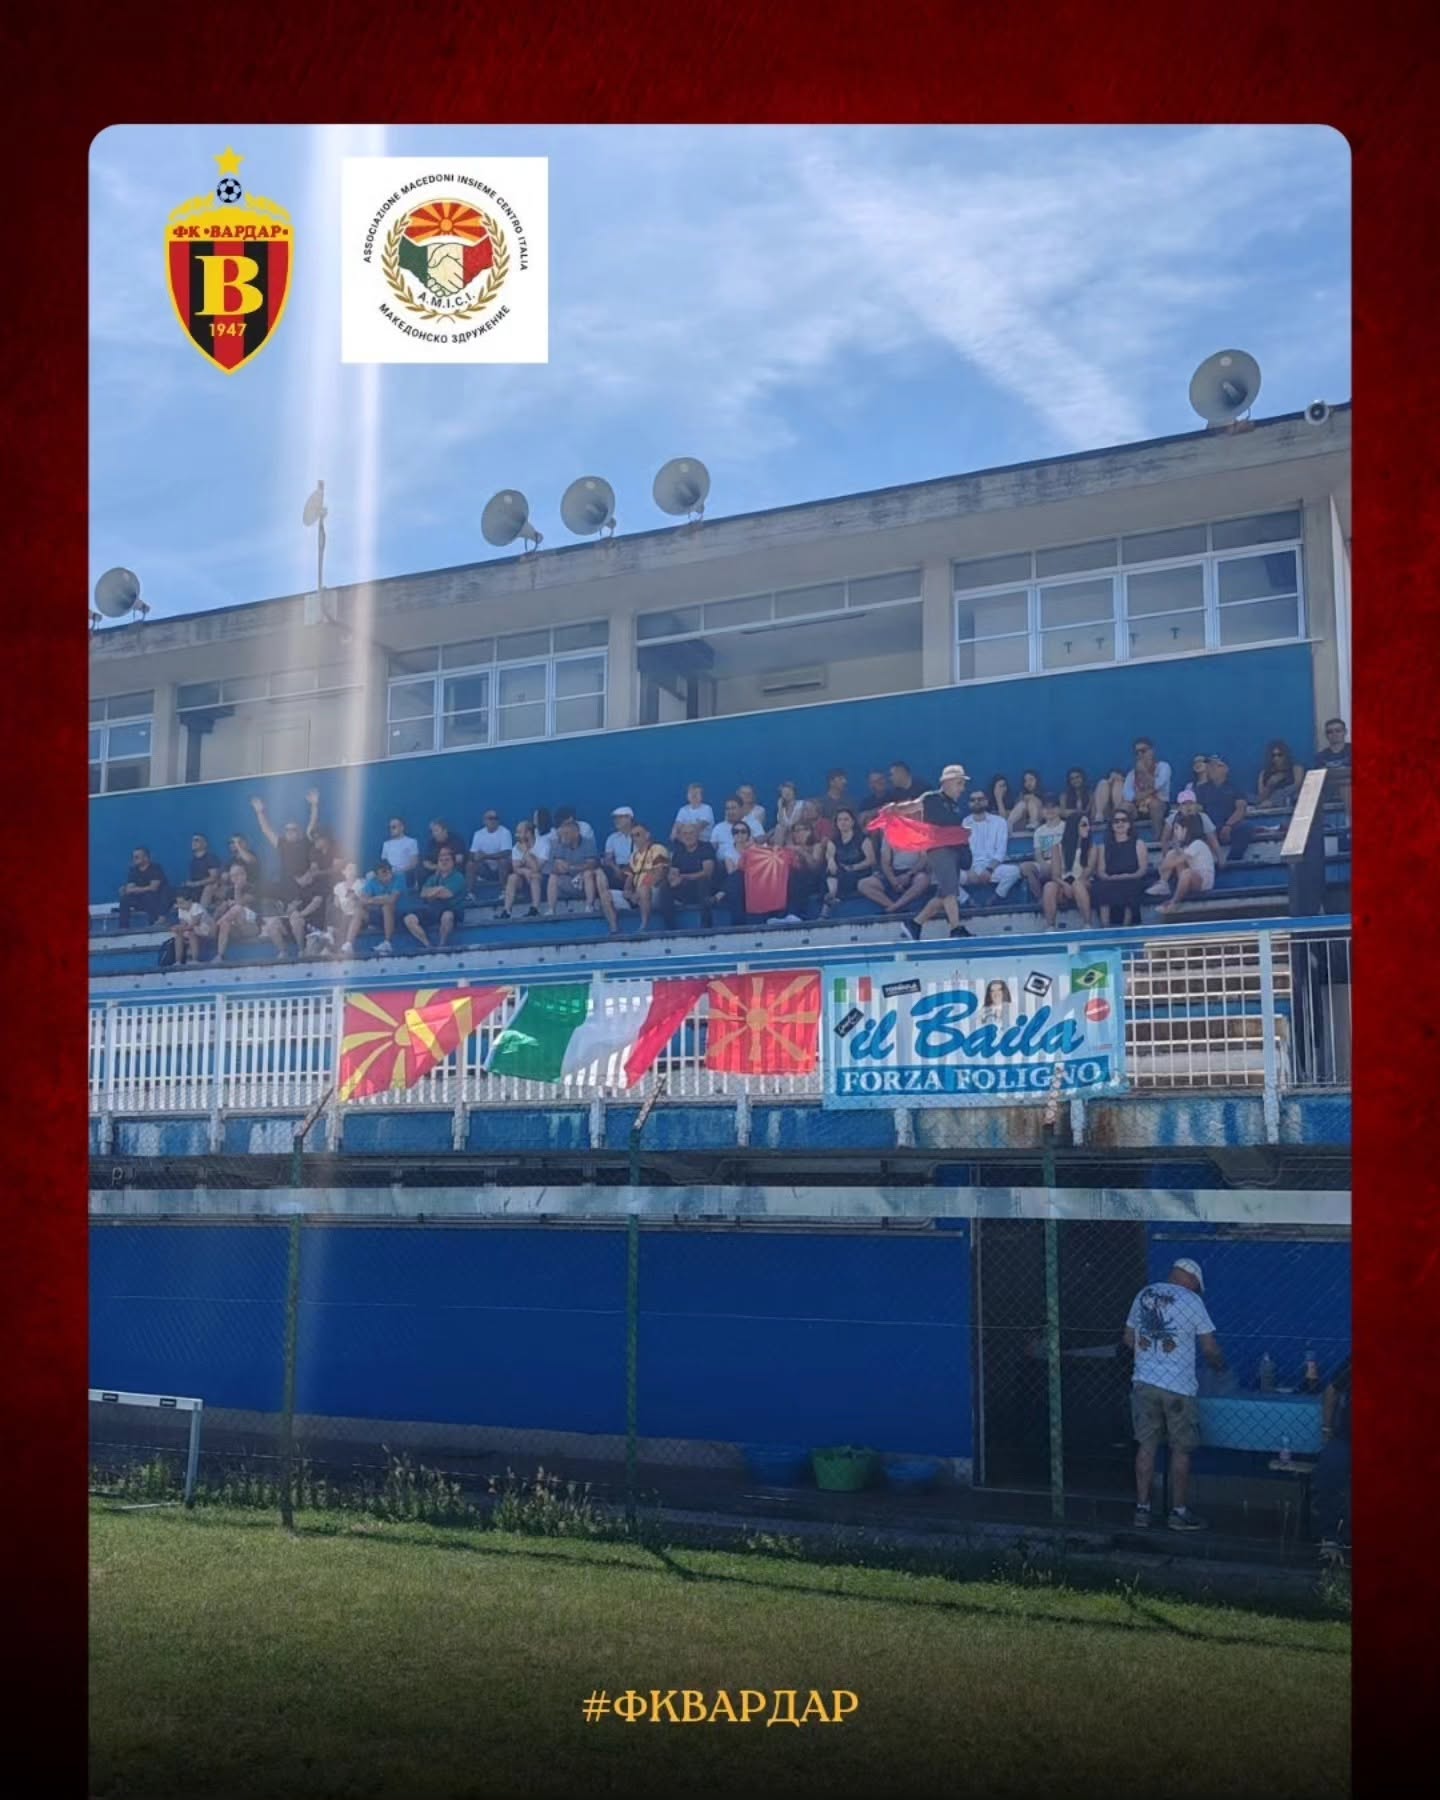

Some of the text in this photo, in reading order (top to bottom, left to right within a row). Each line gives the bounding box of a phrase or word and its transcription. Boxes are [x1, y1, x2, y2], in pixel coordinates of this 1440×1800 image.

[850, 1009, 897, 1060] il
[910, 990, 1085, 1059] Baila
[842, 1069, 944, 1093] FORZA
